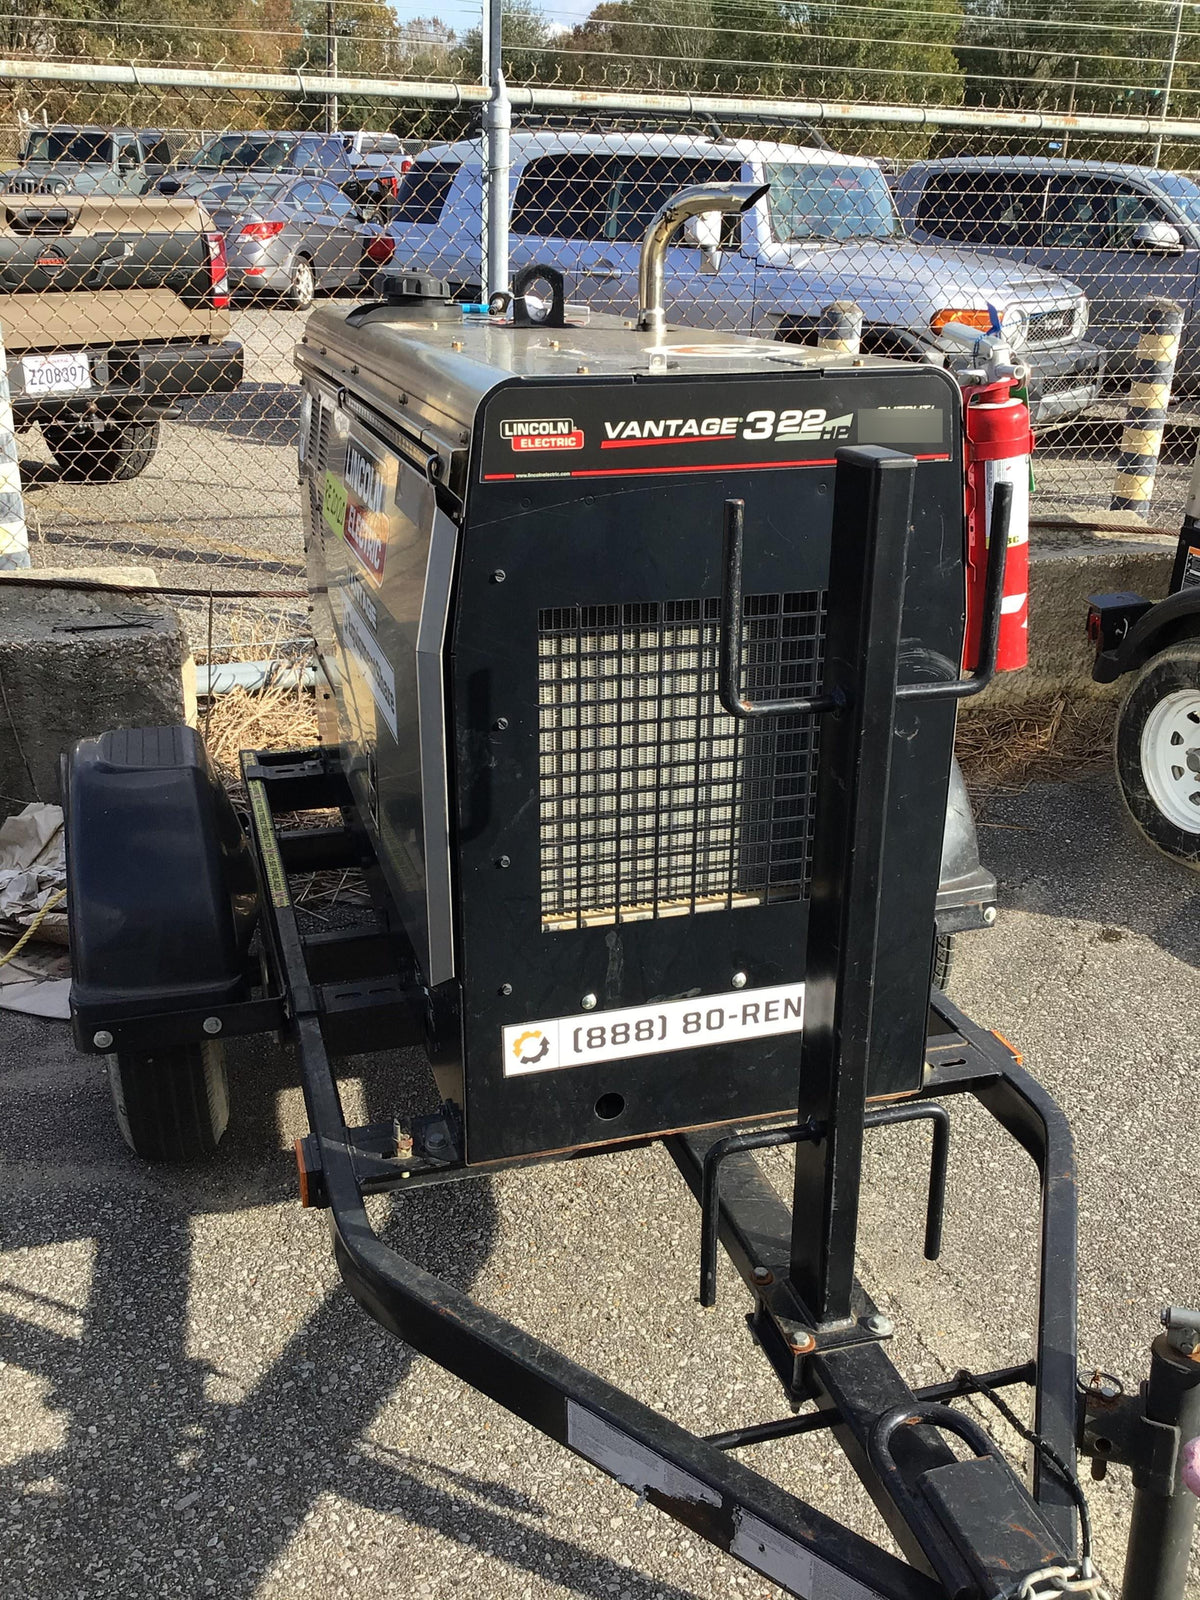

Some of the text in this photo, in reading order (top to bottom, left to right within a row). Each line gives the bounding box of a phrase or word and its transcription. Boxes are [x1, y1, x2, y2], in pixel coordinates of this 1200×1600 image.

[504, 421, 569, 436] LINCOLN
[520, 437, 577, 448] ELECTRIC
[603, 417, 738, 439] VANTAGE
[345, 444, 384, 514] LINCOLN
[347, 504, 382, 570] ELECTRIC
[573, 1015, 667, 1053] (888)
